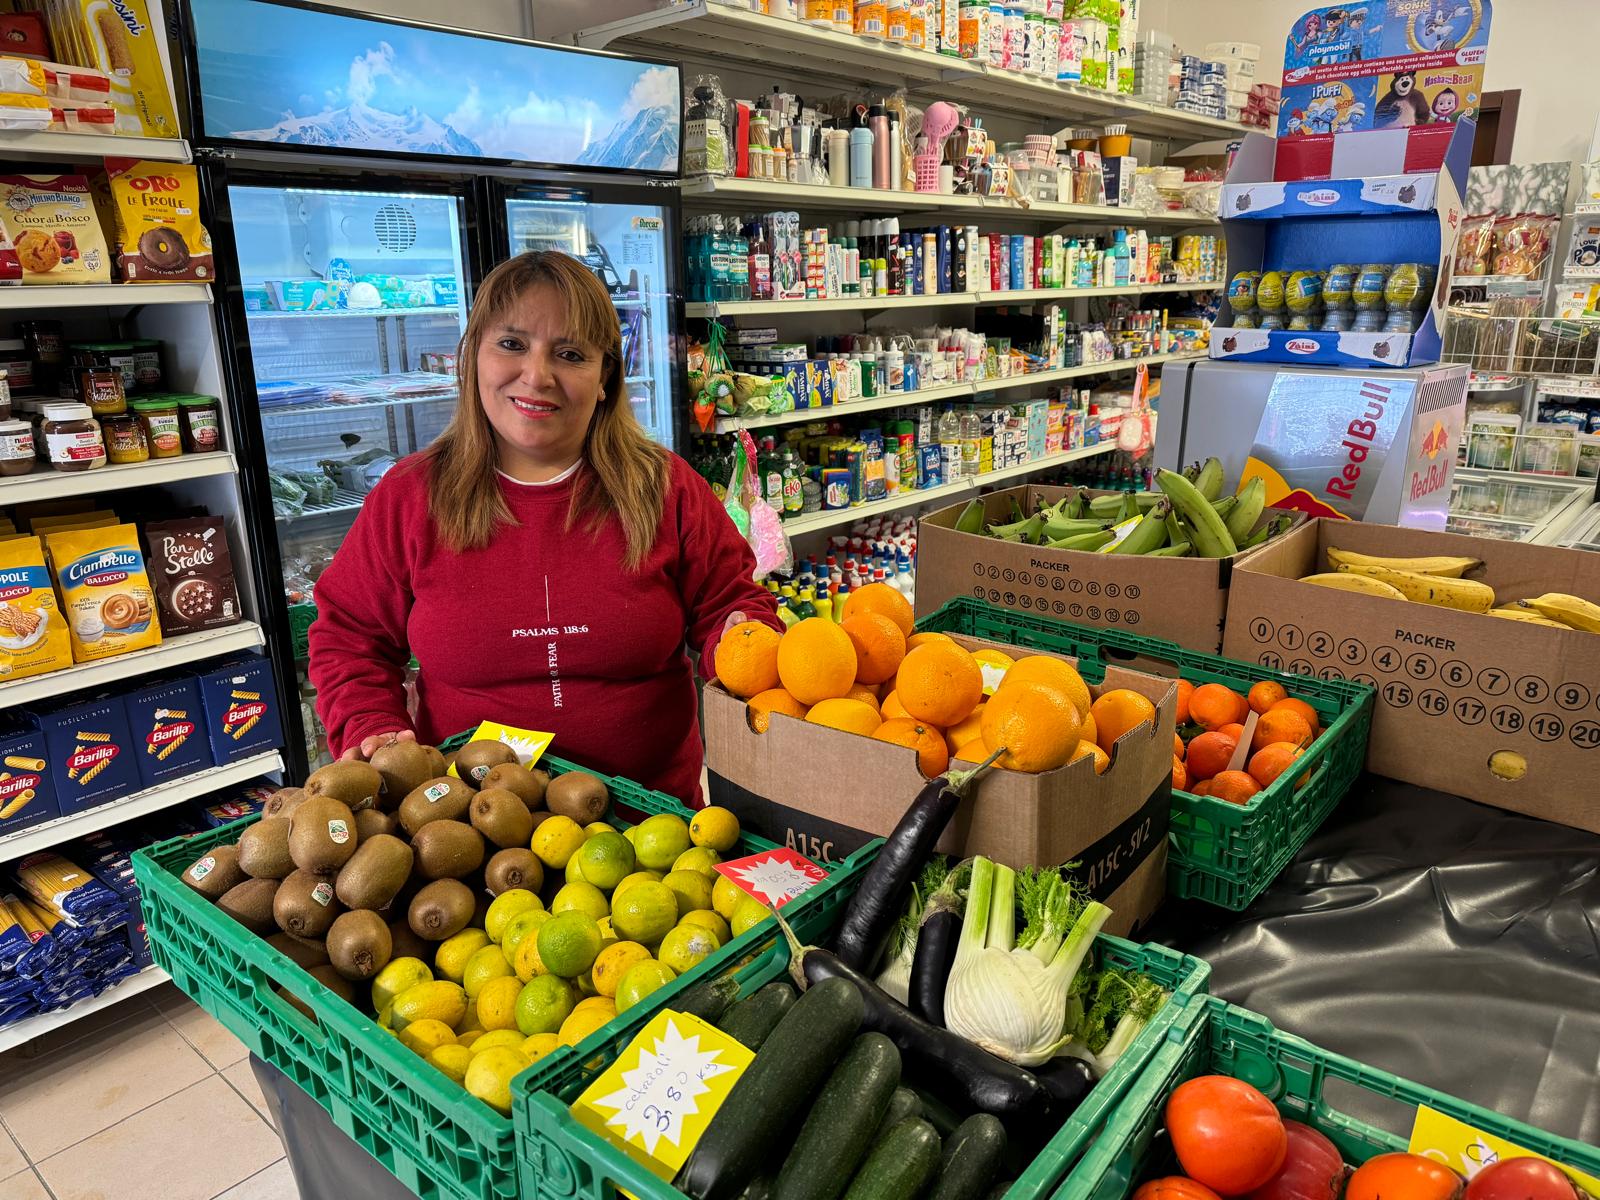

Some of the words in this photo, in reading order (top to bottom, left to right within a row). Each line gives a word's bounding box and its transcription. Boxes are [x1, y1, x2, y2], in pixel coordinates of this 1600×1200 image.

[1309, 41, 1350, 56] playmobil
[1461, 49, 1485, 57] GLUTEN
[1327, 71, 1350, 79] chocolate
[1405, 62, 1425, 70] surprise
[129, 176, 180, 192] ORO
[128, 196, 137, 205] LE
[14, 214, 46, 224] Cuor
[55, 214, 91, 223] Bosco
[1288, 341, 1316, 351] Zaini
[1347, 381, 1392, 442] Bull
[1325, 440, 1370, 500] Red
[785, 480, 801, 496] EKO
[1410, 468, 1431, 502] Red
[1429, 458, 1449, 493] Bull
[163, 536, 190, 558] Pan
[69, 553, 136, 580] Ciambelle
[165, 547, 215, 575] Stelle
[1030, 559, 1070, 572] PACKER
[87, 573, 126, 585] BALOCCO
[512, 627, 559, 637] PSALMS
[563, 625, 589, 634] 118:6
[1395, 629, 1456, 652] PACKER
[548, 642, 558, 668] FEAR
[138, 693, 166, 703] FUSILLI
[552, 679, 562, 708] FAITH
[229, 705, 263, 722] Barilla
[1386, 686, 1409, 704] 15
[1422, 694, 1446, 712] 16
[1459, 702, 1484, 719] 17
[1496, 710, 1521, 729] 18
[1535, 718, 1561, 737] 19
[57, 714, 88, 727] FUSILLI
[153, 725, 189, 742] Barilla
[73, 748, 113, 767] Barilla
[0, 777, 34, 795] arilla
[785, 828, 834, 864] A15C
[1088, 844, 1121, 890] A15C
